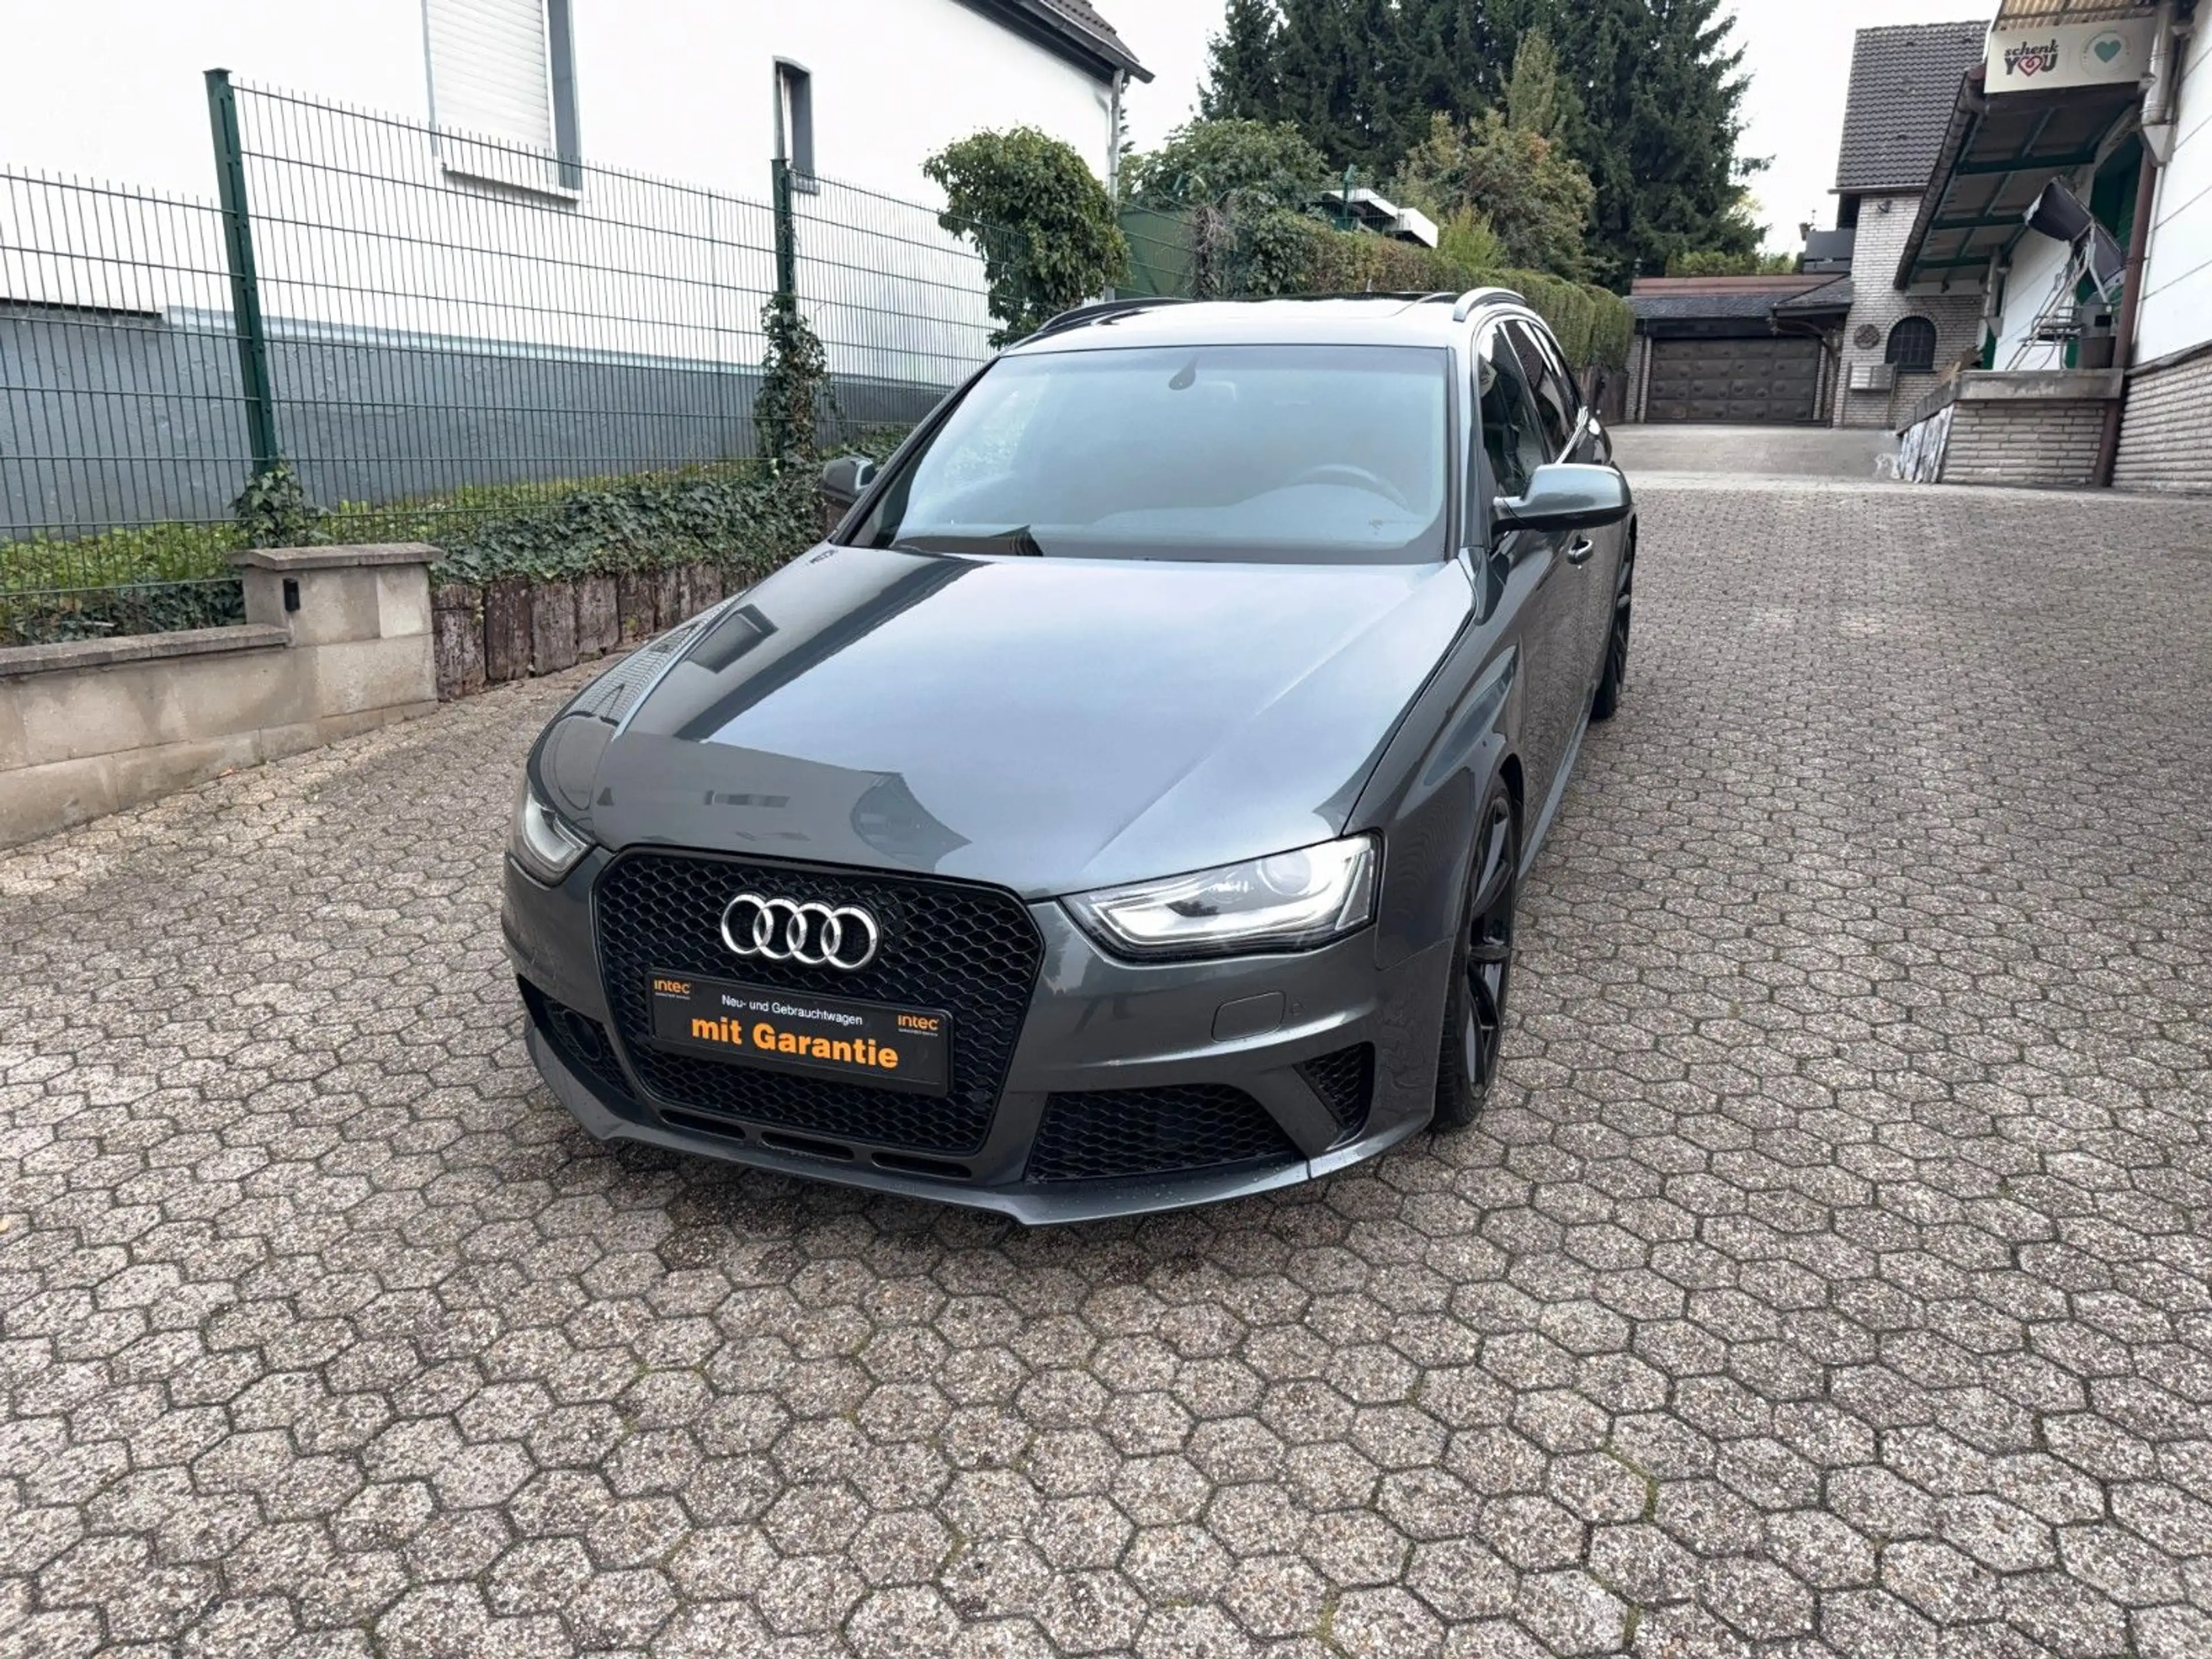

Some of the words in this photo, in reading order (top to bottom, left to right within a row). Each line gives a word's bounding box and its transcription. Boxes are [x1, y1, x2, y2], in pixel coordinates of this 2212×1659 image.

[2004, 39, 2059, 57] schenk
[654, 979, 690, 994] intec
[721, 994, 747, 1007] Neu-
[749, 1001, 770, 1012] und
[772, 1002, 863, 1026] Gebrauchtwagen
[898, 1015, 938, 1031] intec
[692, 1017, 741, 1045] mit
[752, 1022, 899, 1069] Garantie
